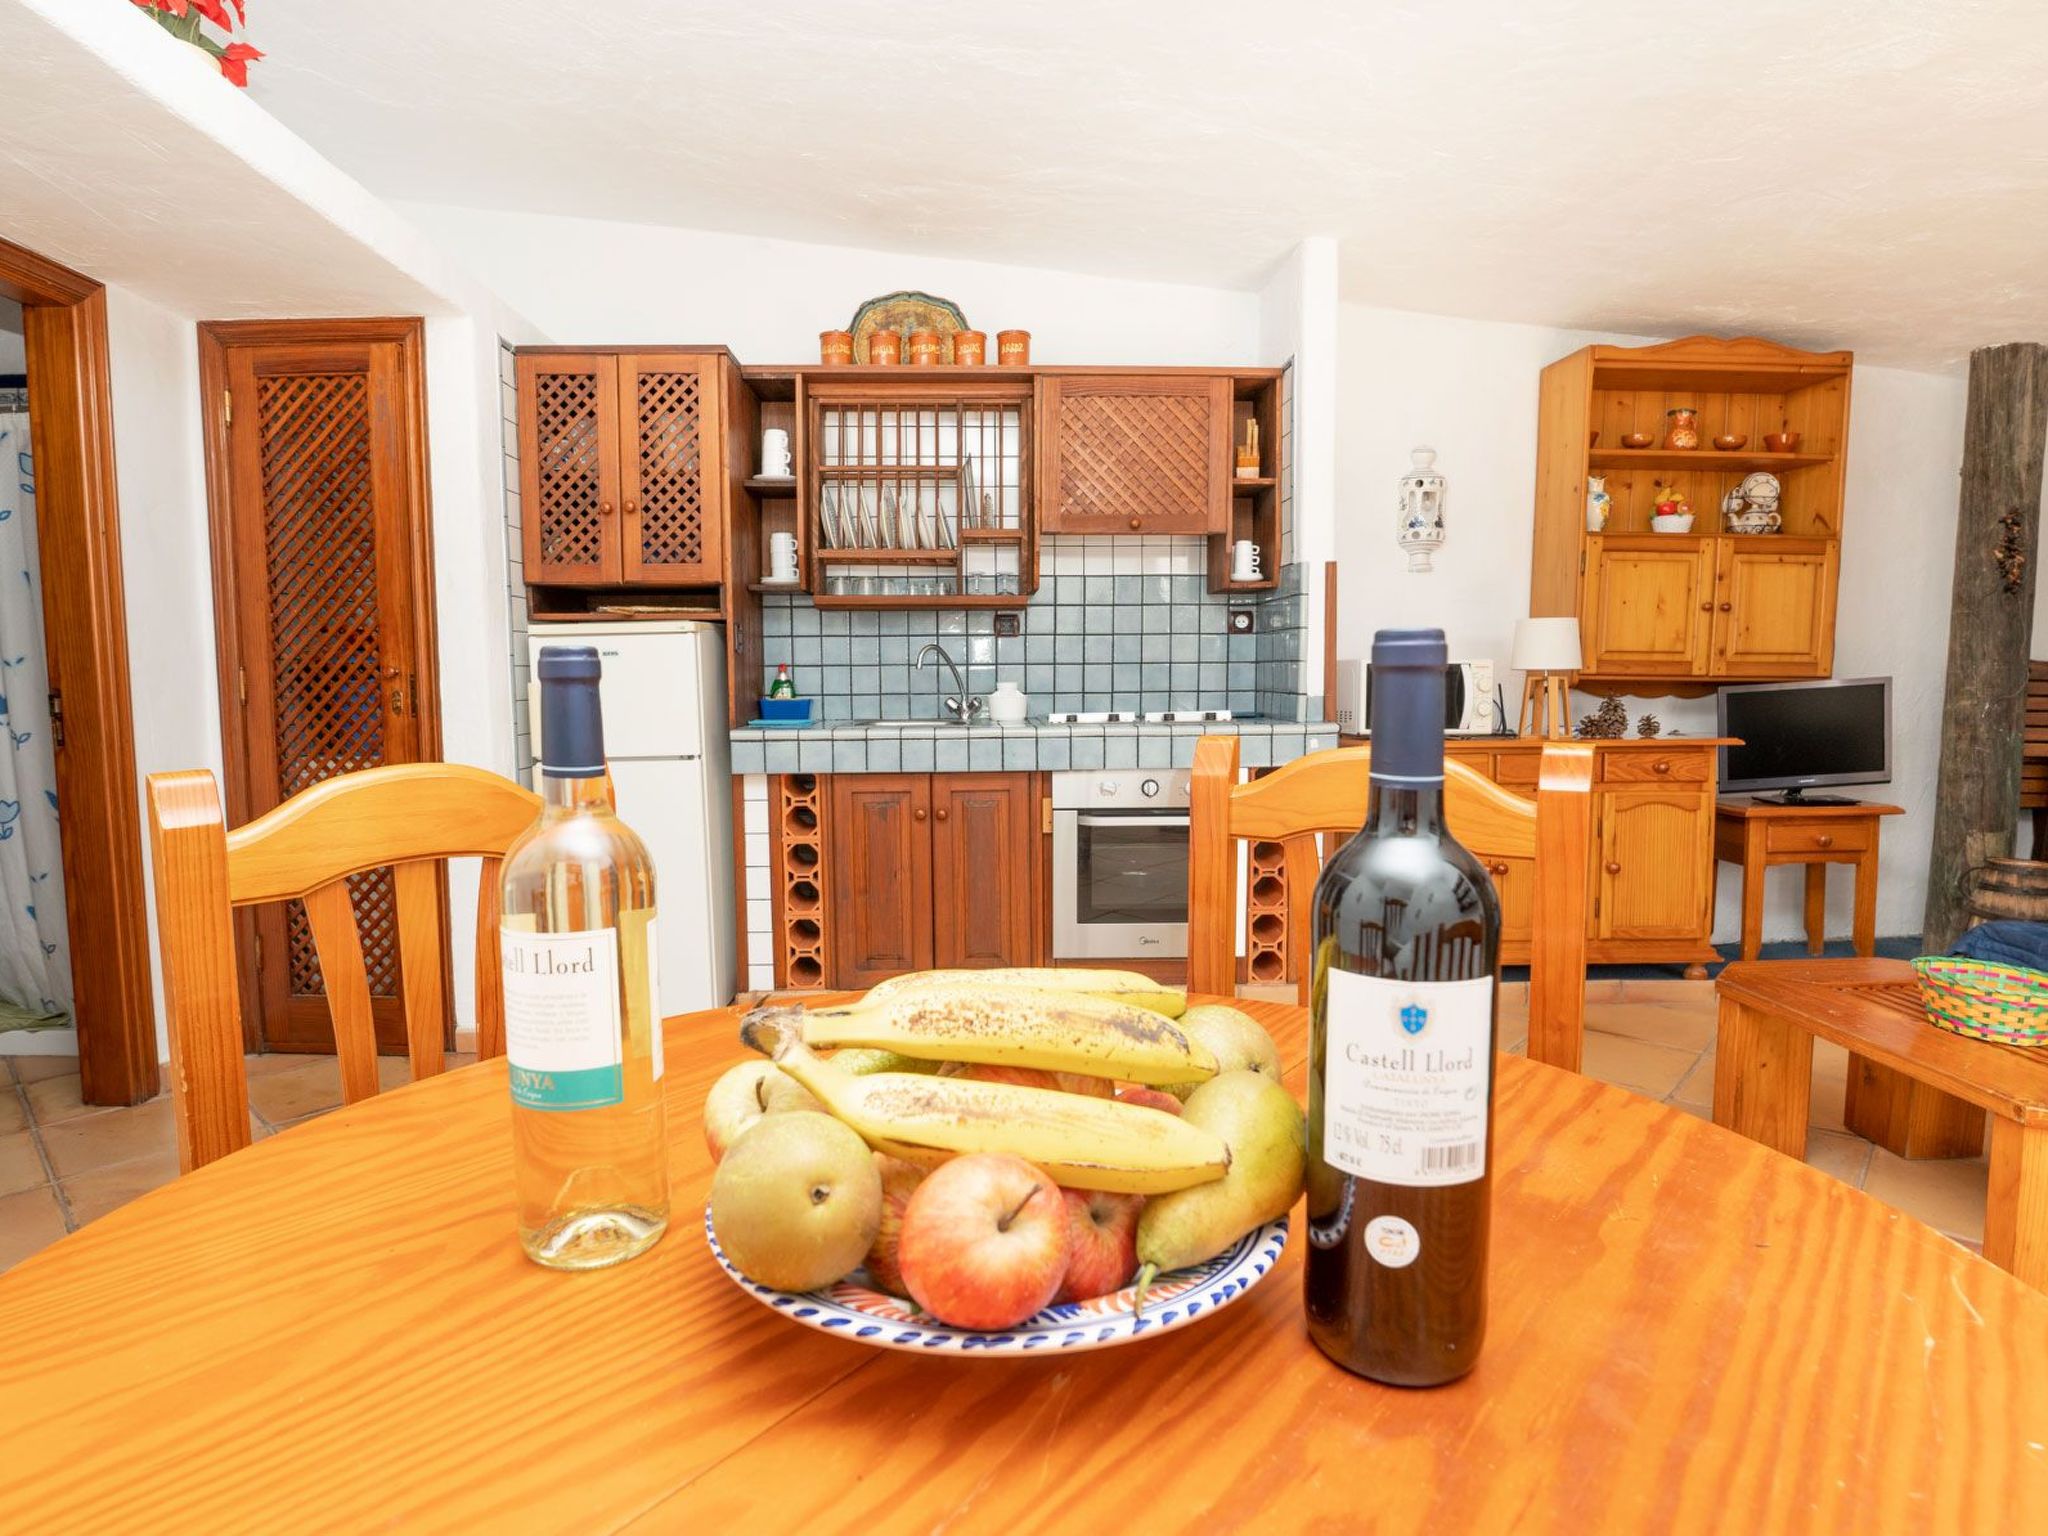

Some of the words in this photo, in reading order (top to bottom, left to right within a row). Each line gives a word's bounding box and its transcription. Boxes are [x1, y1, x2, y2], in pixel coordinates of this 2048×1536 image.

[534, 947, 595, 975] Llord
[1346, 1041, 1415, 1072] Castell
[1426, 1046, 1474, 1073] Llord
